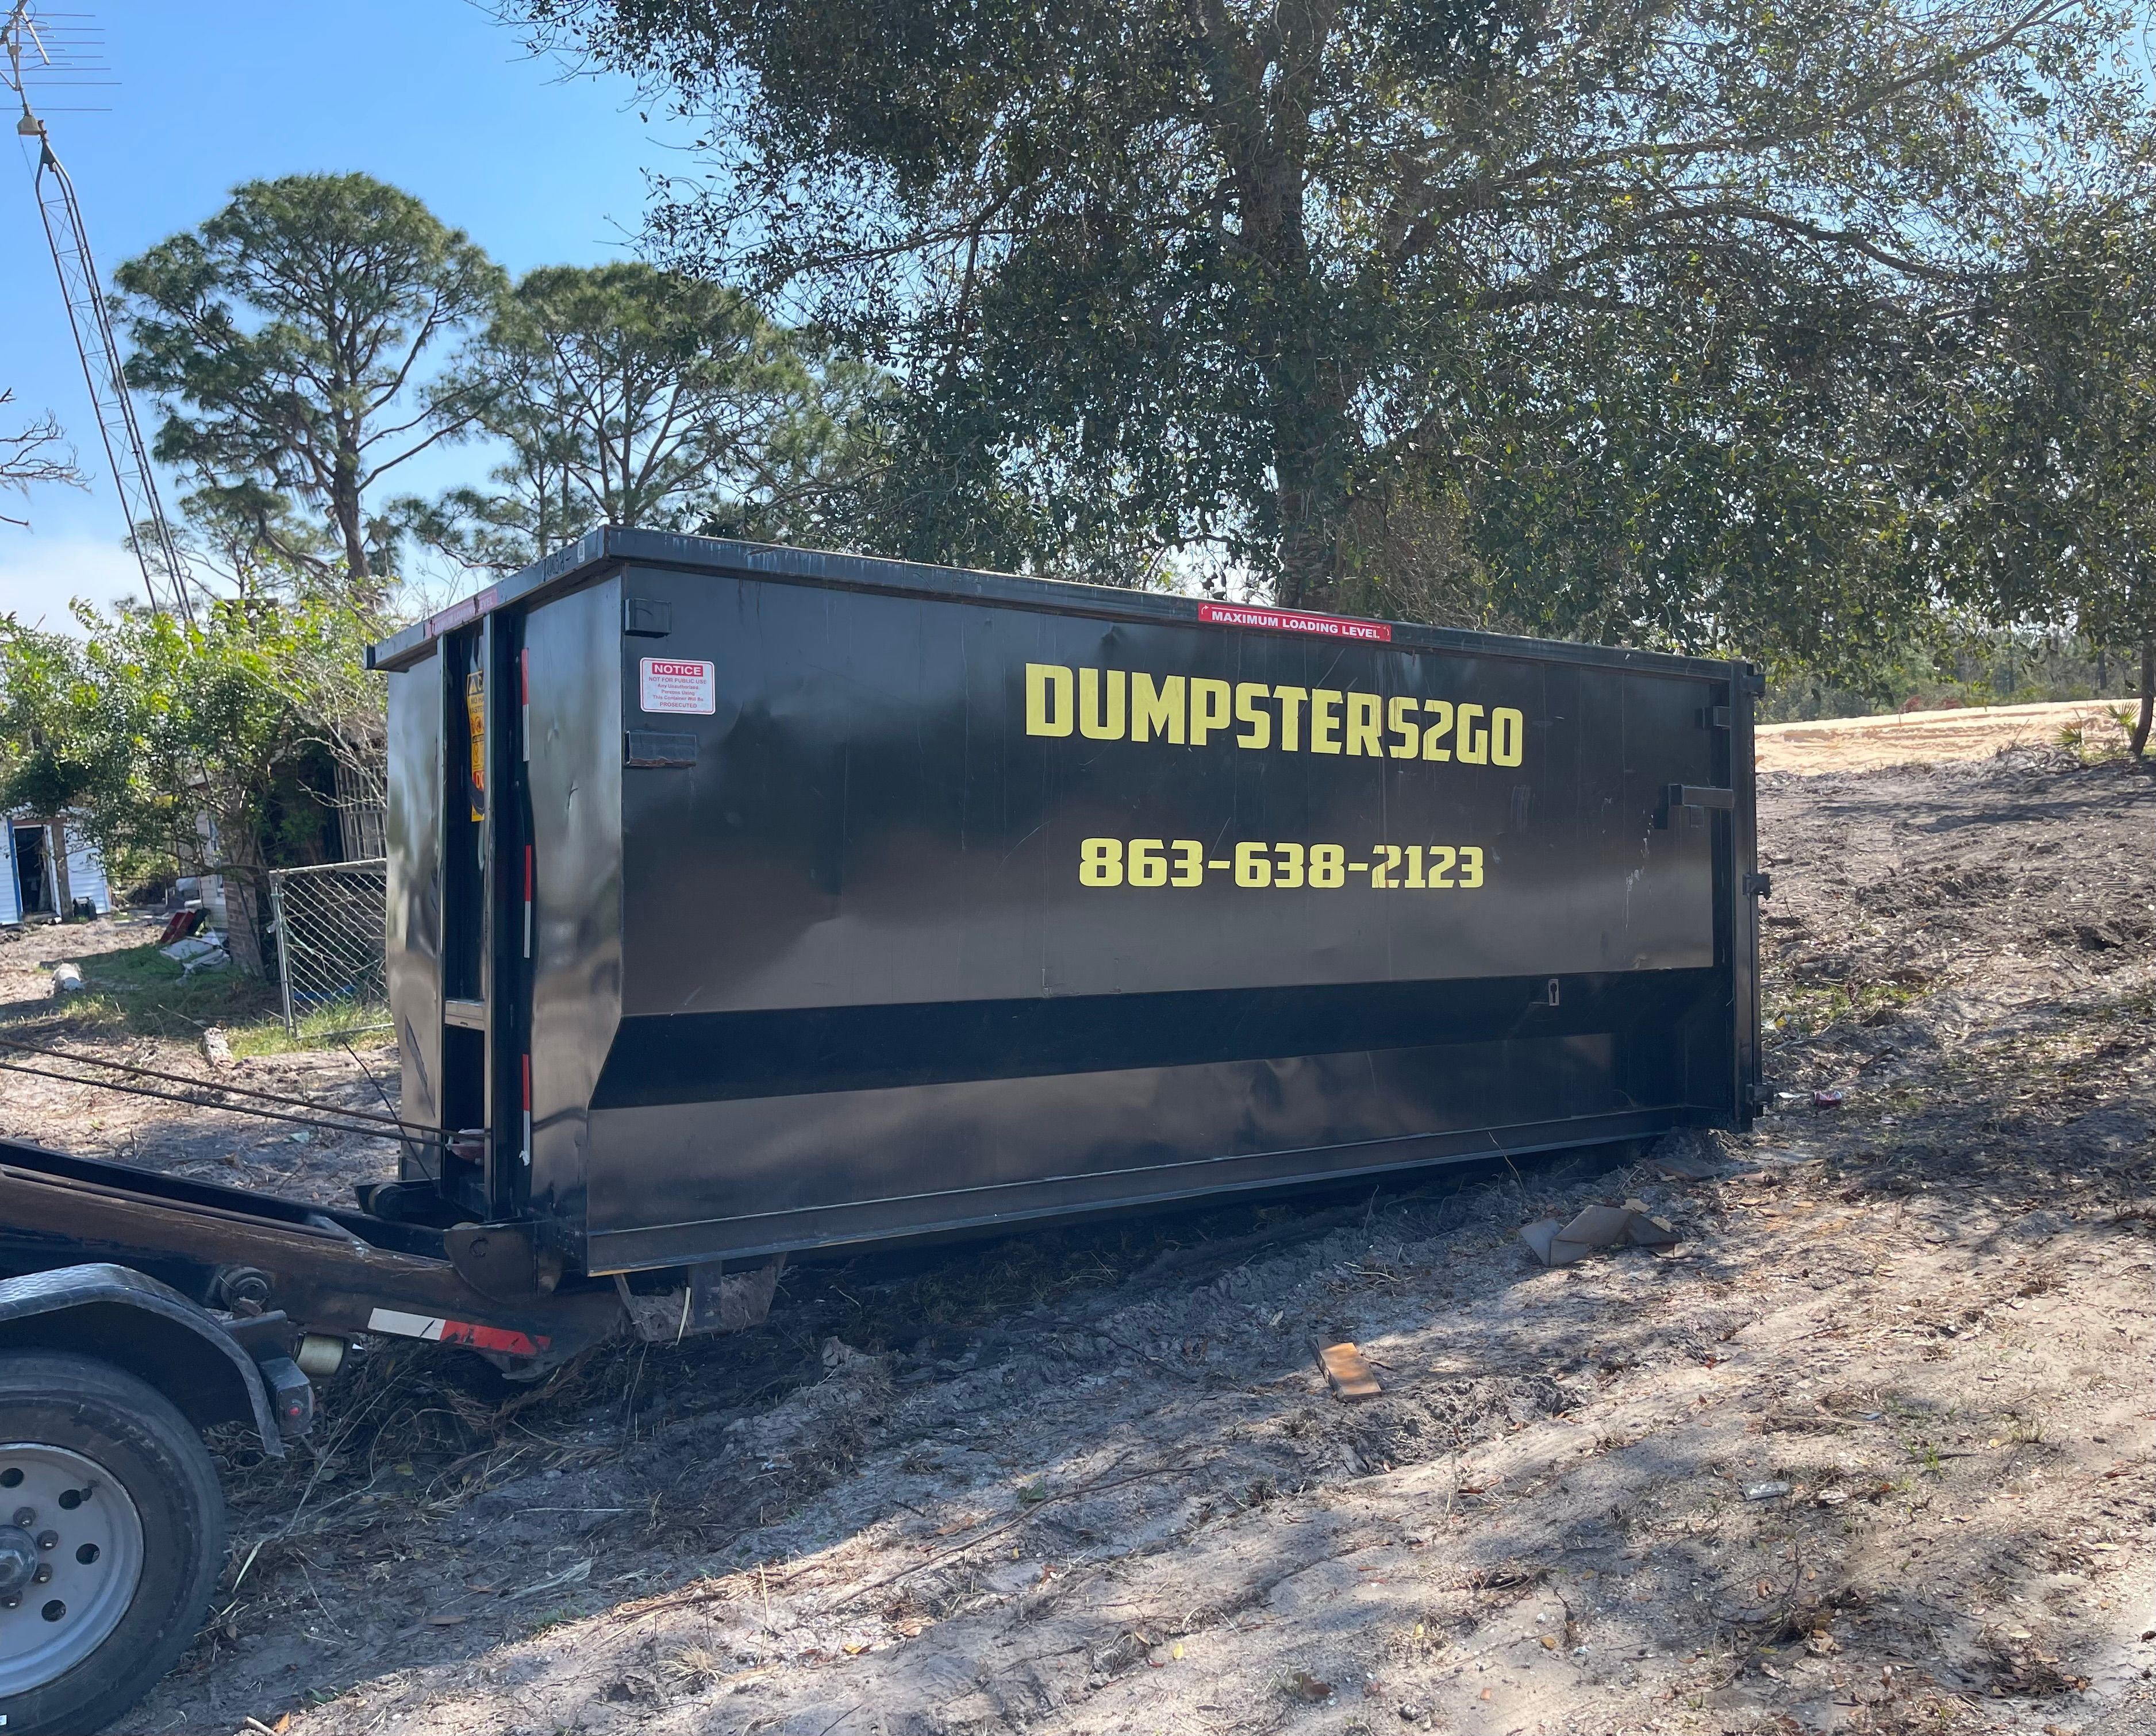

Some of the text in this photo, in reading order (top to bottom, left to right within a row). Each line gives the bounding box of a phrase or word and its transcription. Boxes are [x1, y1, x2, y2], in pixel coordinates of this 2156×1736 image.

[1212, 611, 1380, 639] MAXIMUM LOADING LEVEL
[654, 664, 701, 675] NOTICE
[1025, 663, 1523, 767] DUMPSTERS2GO
[1079, 838, 1484, 888] 863-638-2123
